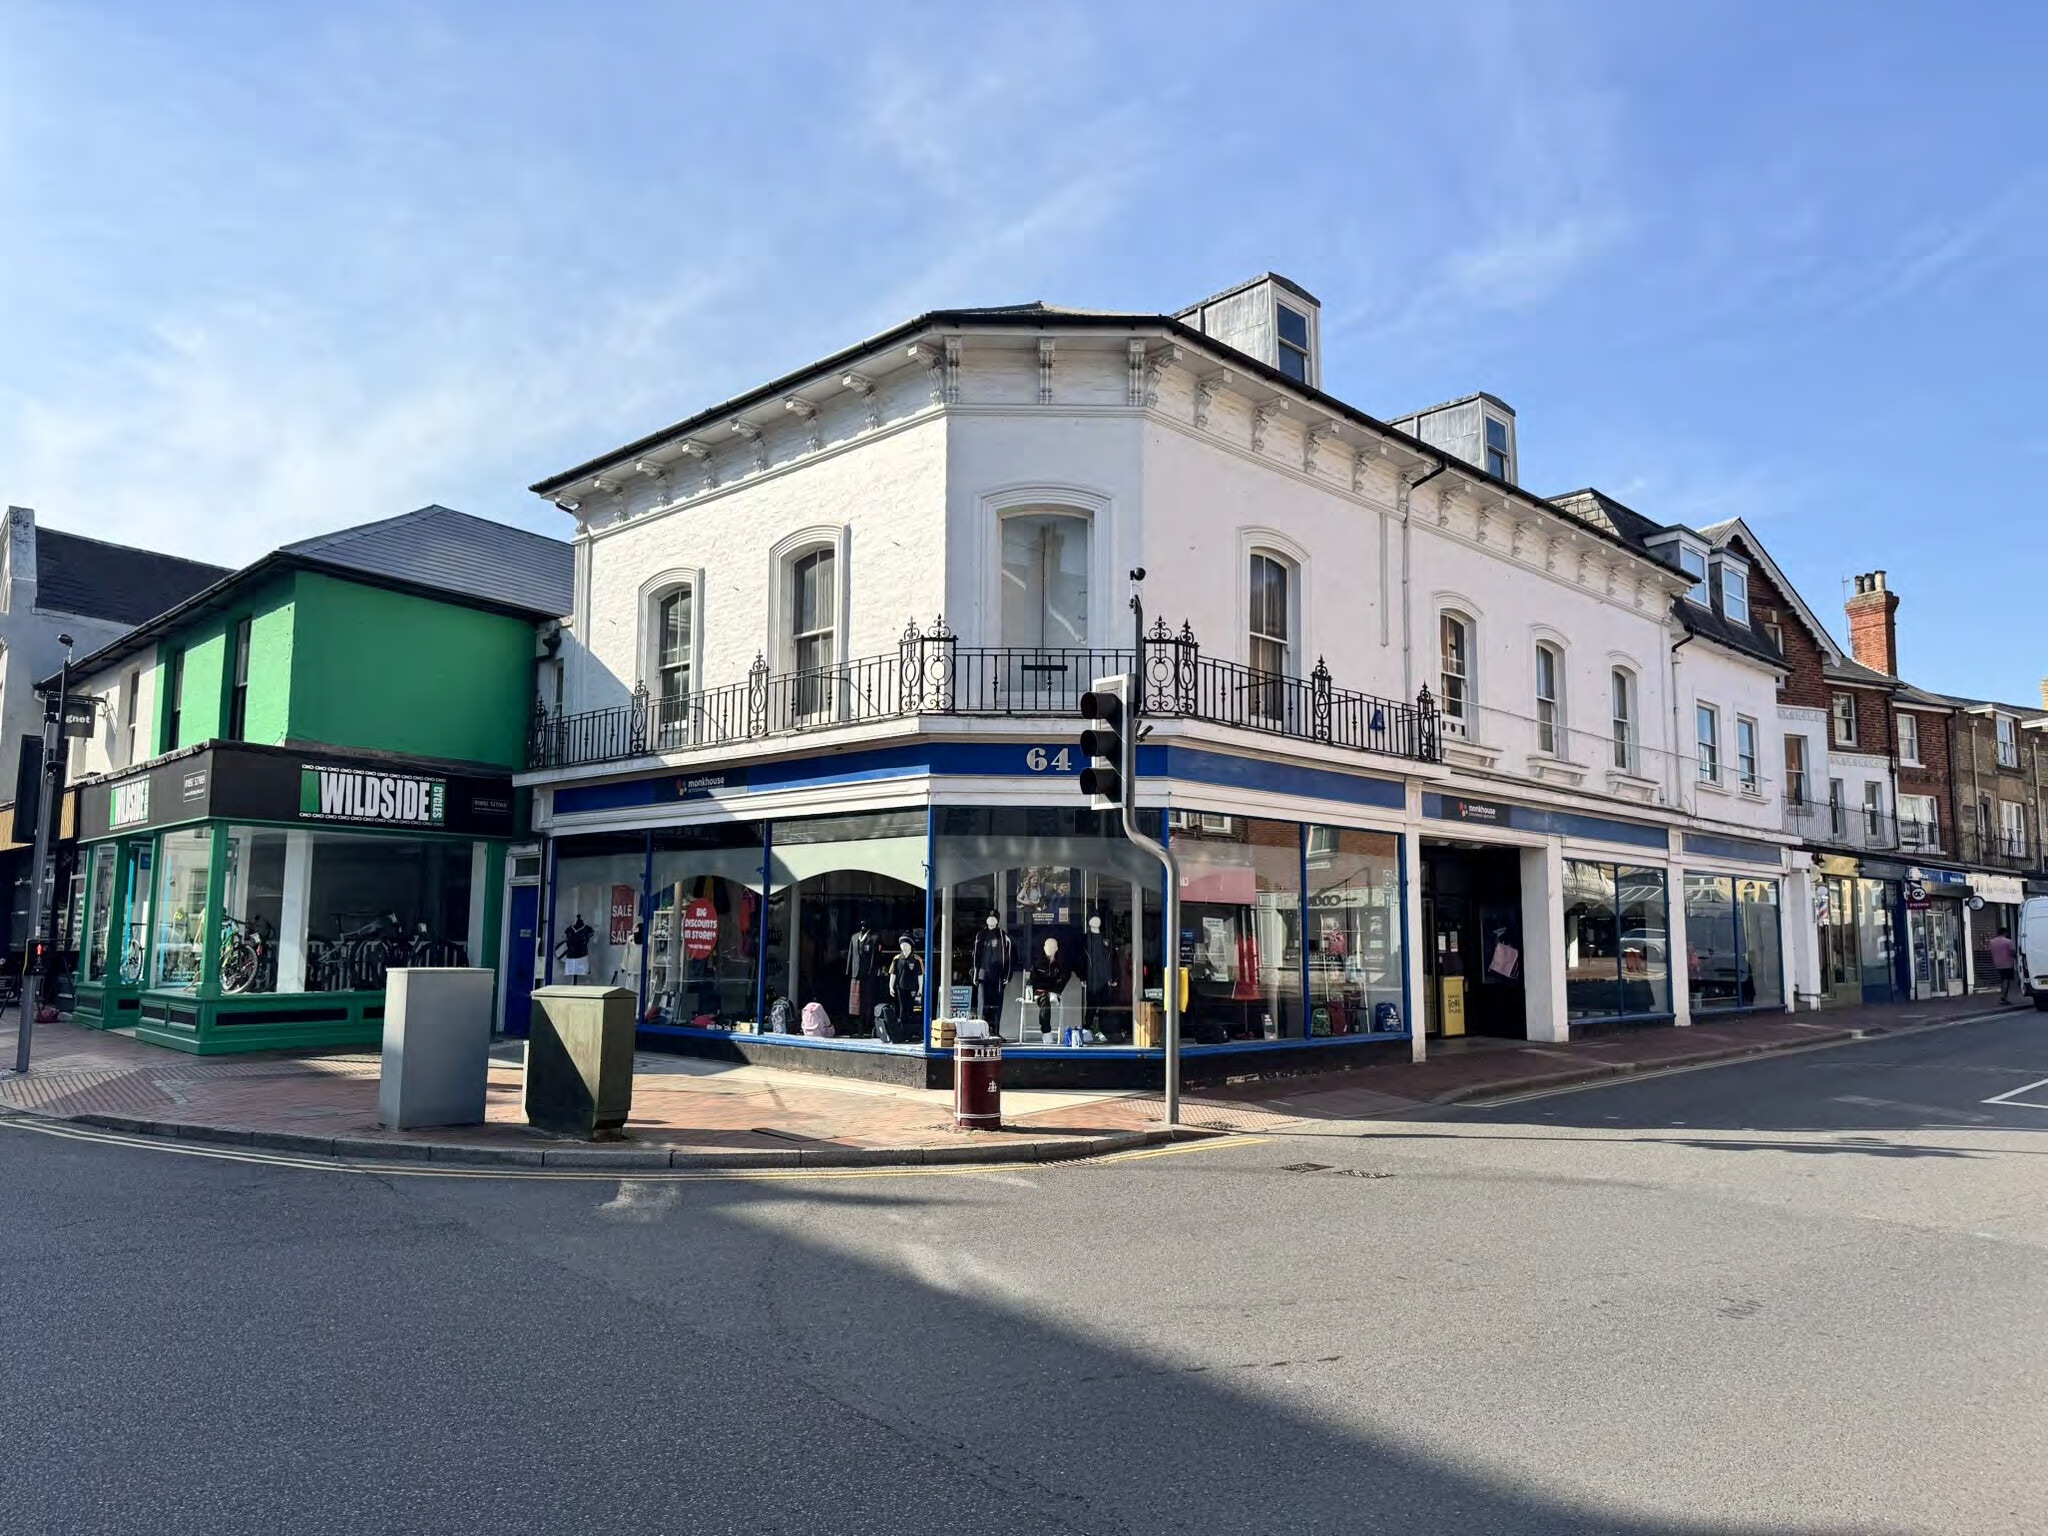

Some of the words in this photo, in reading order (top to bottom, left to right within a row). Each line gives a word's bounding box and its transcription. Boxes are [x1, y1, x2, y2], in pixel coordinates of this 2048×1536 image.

[65, 714, 91, 724] gnet
[1026, 747, 1072, 771] 64
[688, 776, 725, 787] monkhouse
[320, 771, 430, 820] WILDSIDE
[432, 786, 444, 819] CYCLES
[1468, 805, 1496, 815] monkhouse
[612, 904, 633, 917] SALE
[696, 907, 707, 917] BIG
[684, 918, 718, 929] DISCOUNTS
